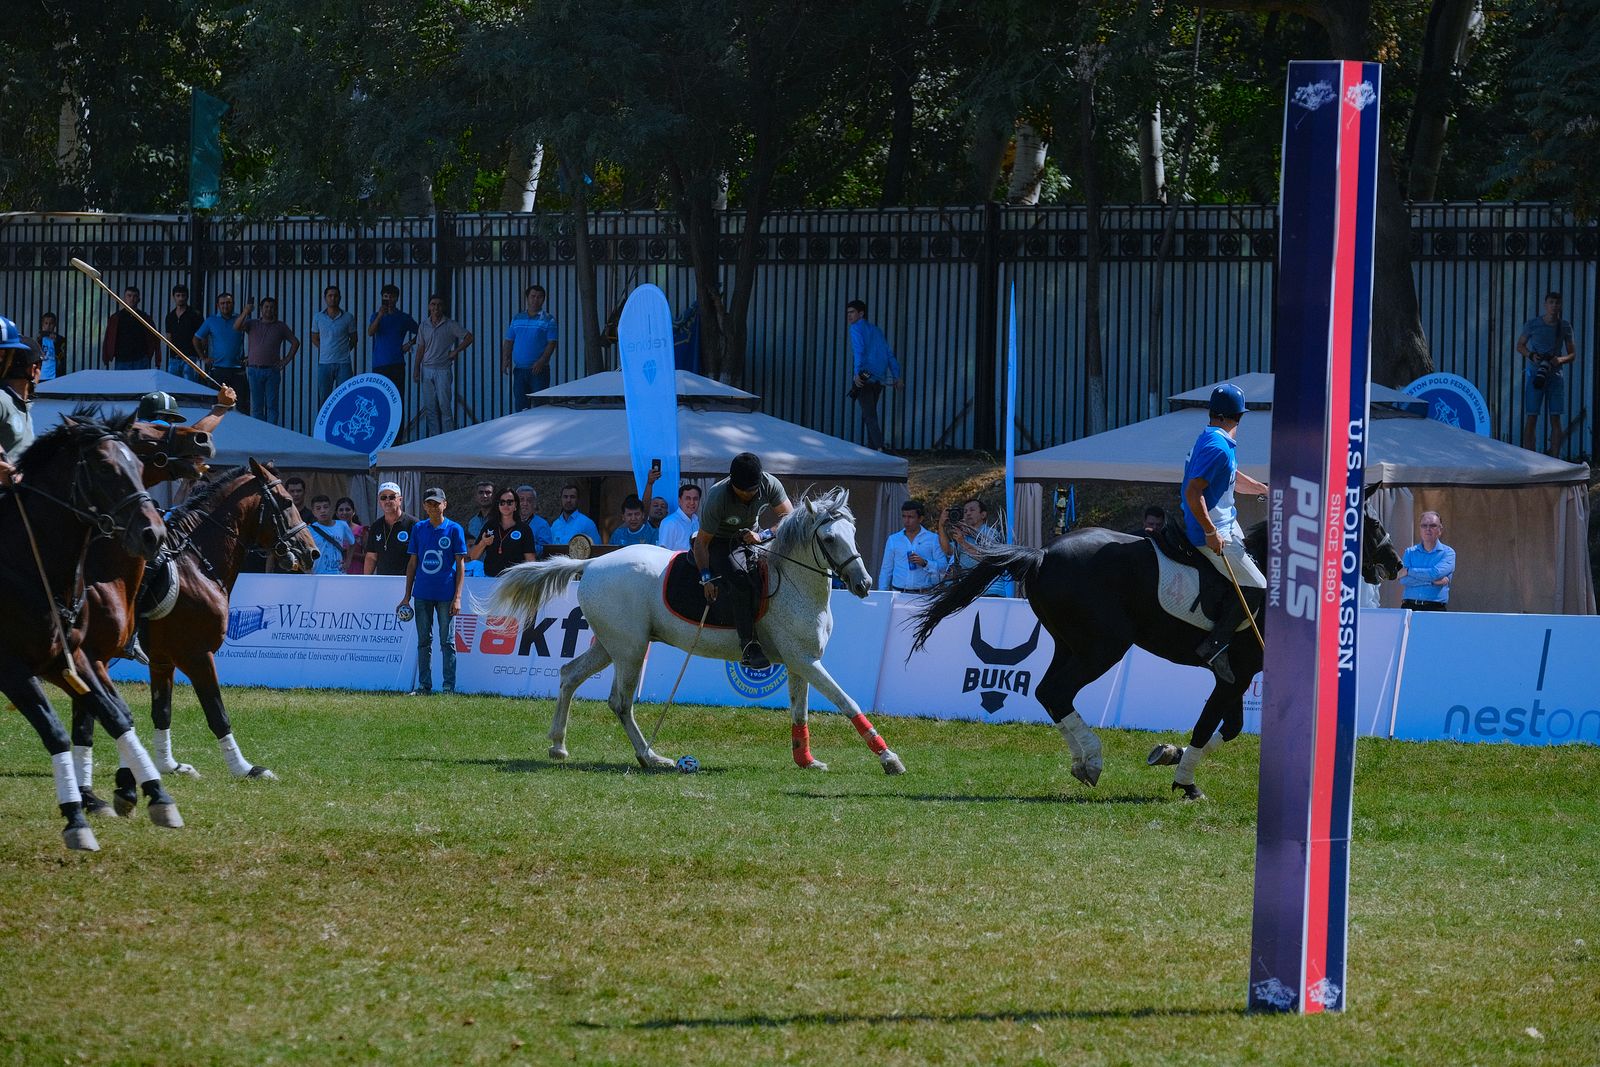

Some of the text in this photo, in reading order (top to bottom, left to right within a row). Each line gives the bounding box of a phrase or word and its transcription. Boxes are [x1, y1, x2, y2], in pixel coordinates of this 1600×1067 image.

[347, 377, 365, 388] POLO
[1428, 377, 1449, 385] POLO
[1449, 378, 1486, 424] FEDERATSIYASI
[1268, 488, 1283, 608] ENERGY DRINK
[1285, 475, 1320, 621] PULS
[1325, 493, 1341, 604] SINCE 1890
[1338, 418, 1363, 678] U.S. POLO ASSN.
[272, 632, 403, 644] INTERNATIONAL UNIVERSITY IN TASHKENT
[225, 650, 257, 659] Accredited
[258, 650, 289, 659] Institution
[289, 651, 297, 660] of
[297, 651, 307, 660] the
[308, 651, 339, 663] University
[340, 653, 348, 662] of
[349, 653, 385, 663] Westminster
[385, 654, 403, 665] (UK)
[493, 665, 527, 676] GROUP
[528, 667, 543, 676] OF
[962, 667, 1032, 697] BUKA
